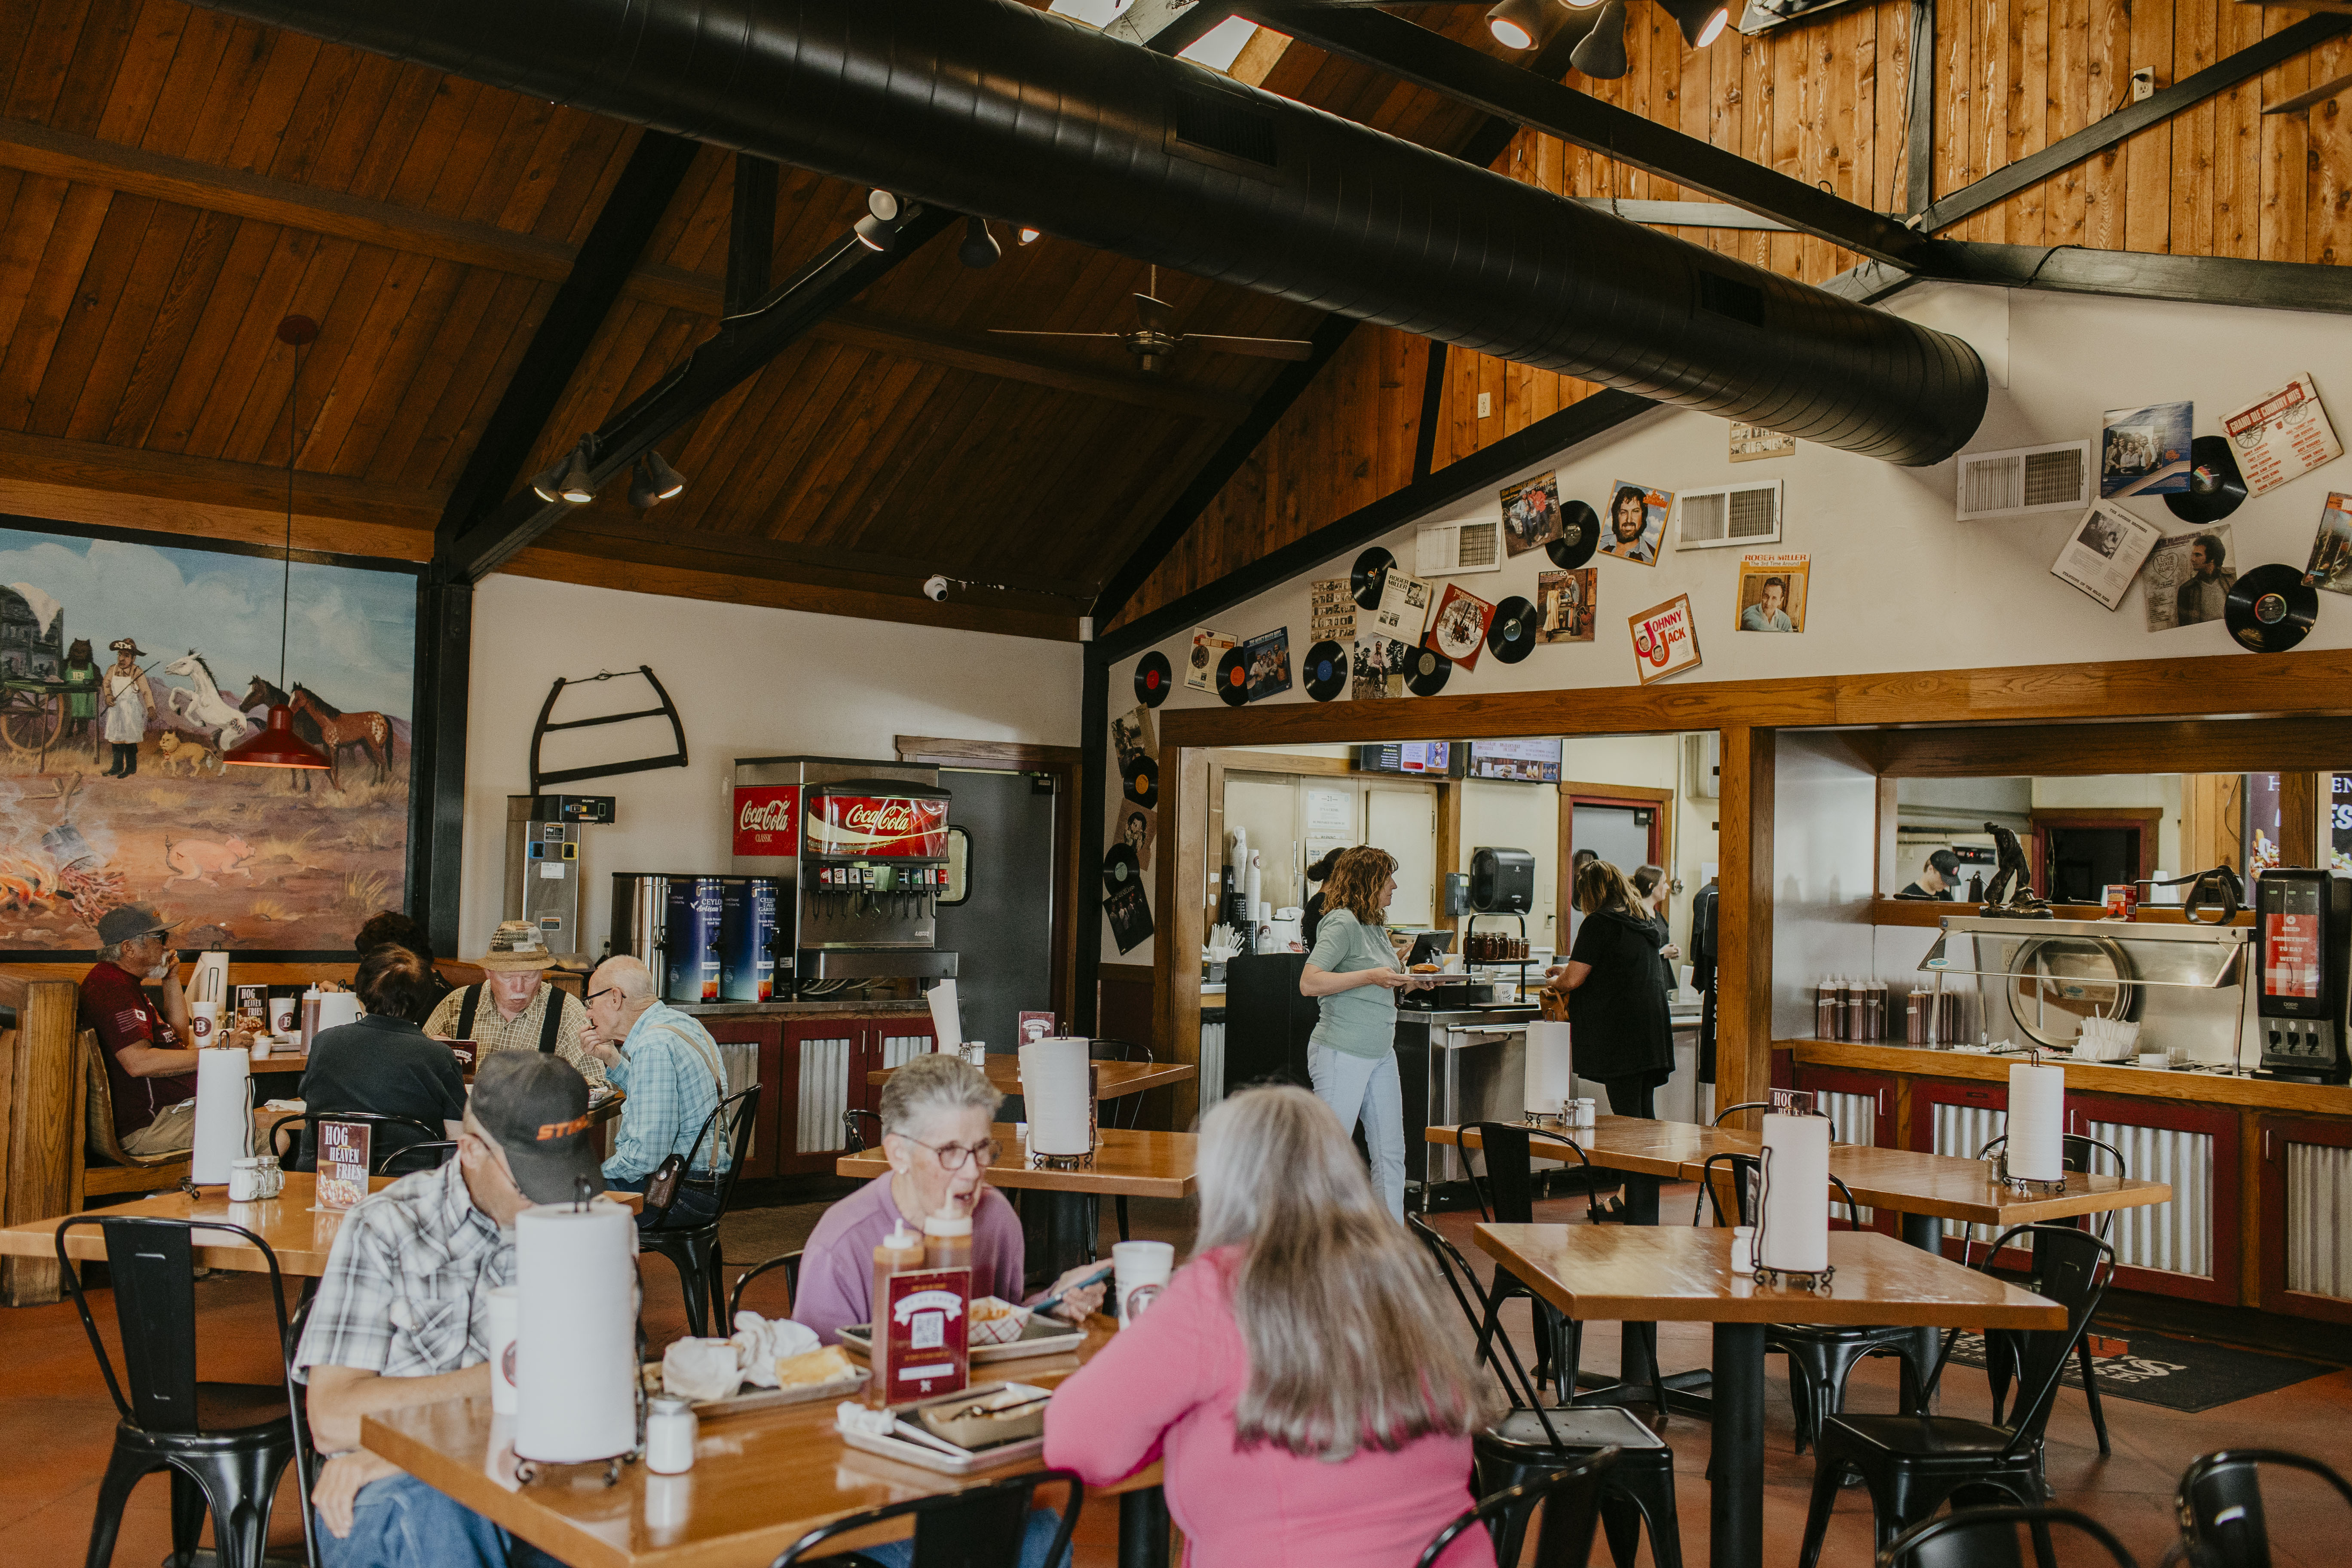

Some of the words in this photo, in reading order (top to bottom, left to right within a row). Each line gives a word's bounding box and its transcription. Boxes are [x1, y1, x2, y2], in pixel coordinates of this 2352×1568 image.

[2230, 416, 2251, 433] GRAND
[2250, 410, 2262, 423] OLE
[2261, 395, 2288, 418] COUNTRY
[2287, 388, 2301, 403] HITS
[2254, 443, 2268, 452] ARNOLD
[2306, 439, 2320, 448] ROGERS
[2259, 457, 2272, 466] GIBSON
[2246, 471, 2259, 480] HOMER
[2268, 460, 2282, 469] JETHRO
[2118, 512, 2131, 523] ANCHOR
[2132, 521, 2147, 533] BROTHERS
[2158, 565, 2174, 574] BLUES
[1388, 580, 1408, 590] MILLER
[1389, 575, 1409, 585] ROGER
[740, 800, 791, 831] Coca-Cola
[845, 804, 912, 830] Coca-Cola
[755, 833, 772, 842] CLASSIC
[242, 988, 255, 999] HOG
[244, 999, 261, 1008] HEAVEN
[248, 1008, 263, 1016] FRIES
[196, 1020, 206, 1032] B
[283, 1016, 291, 1028] B
[325, 1125, 348, 1146] HOG
[329, 1147, 359, 1163] HEAVEN
[336, 1163, 361, 1181] FRIES
